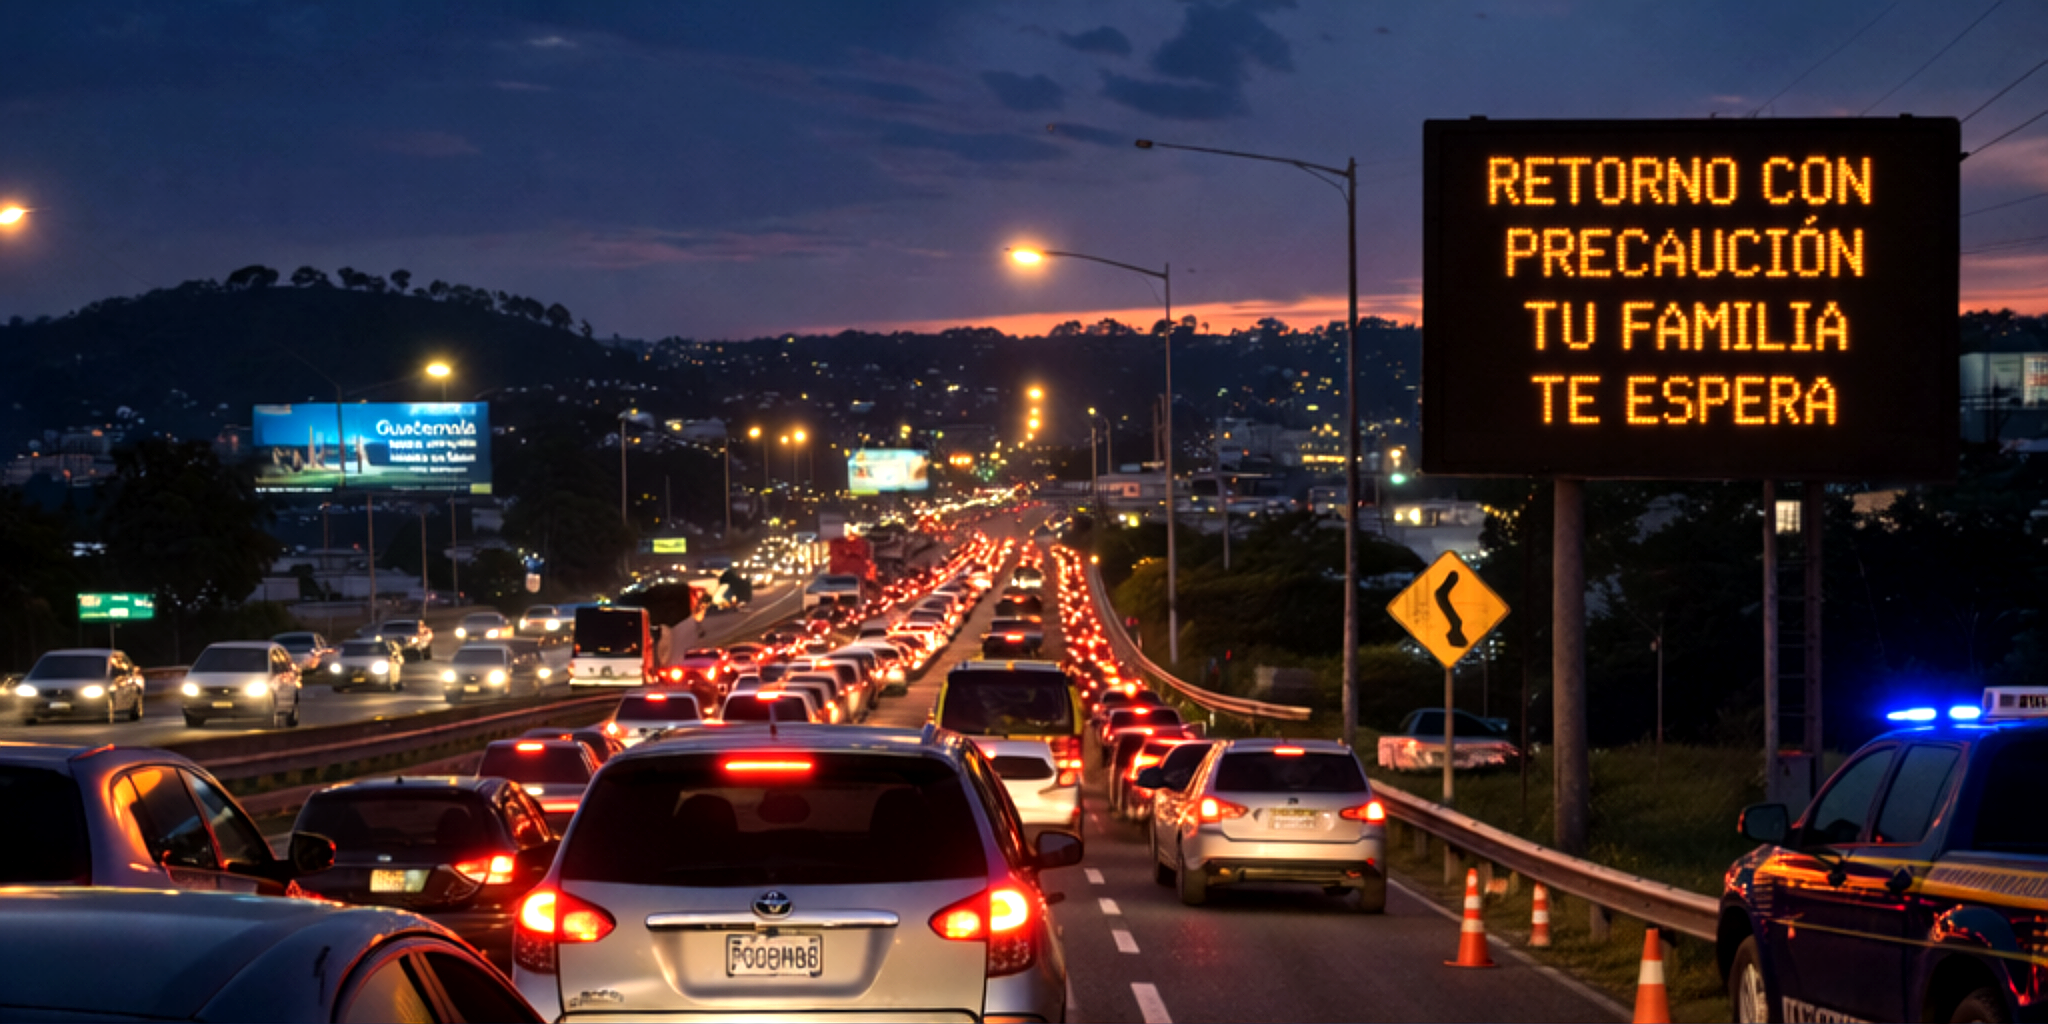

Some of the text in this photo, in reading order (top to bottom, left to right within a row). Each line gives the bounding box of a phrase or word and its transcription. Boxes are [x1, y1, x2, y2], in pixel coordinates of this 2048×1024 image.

[1488, 156, 1873, 206] RETORNO CON
[1506, 215, 1865, 279] PRECAUCIÓN
[1524, 301, 1849, 351] TU FAMILIA
[1531, 374, 1839, 425] TE ESPERA
